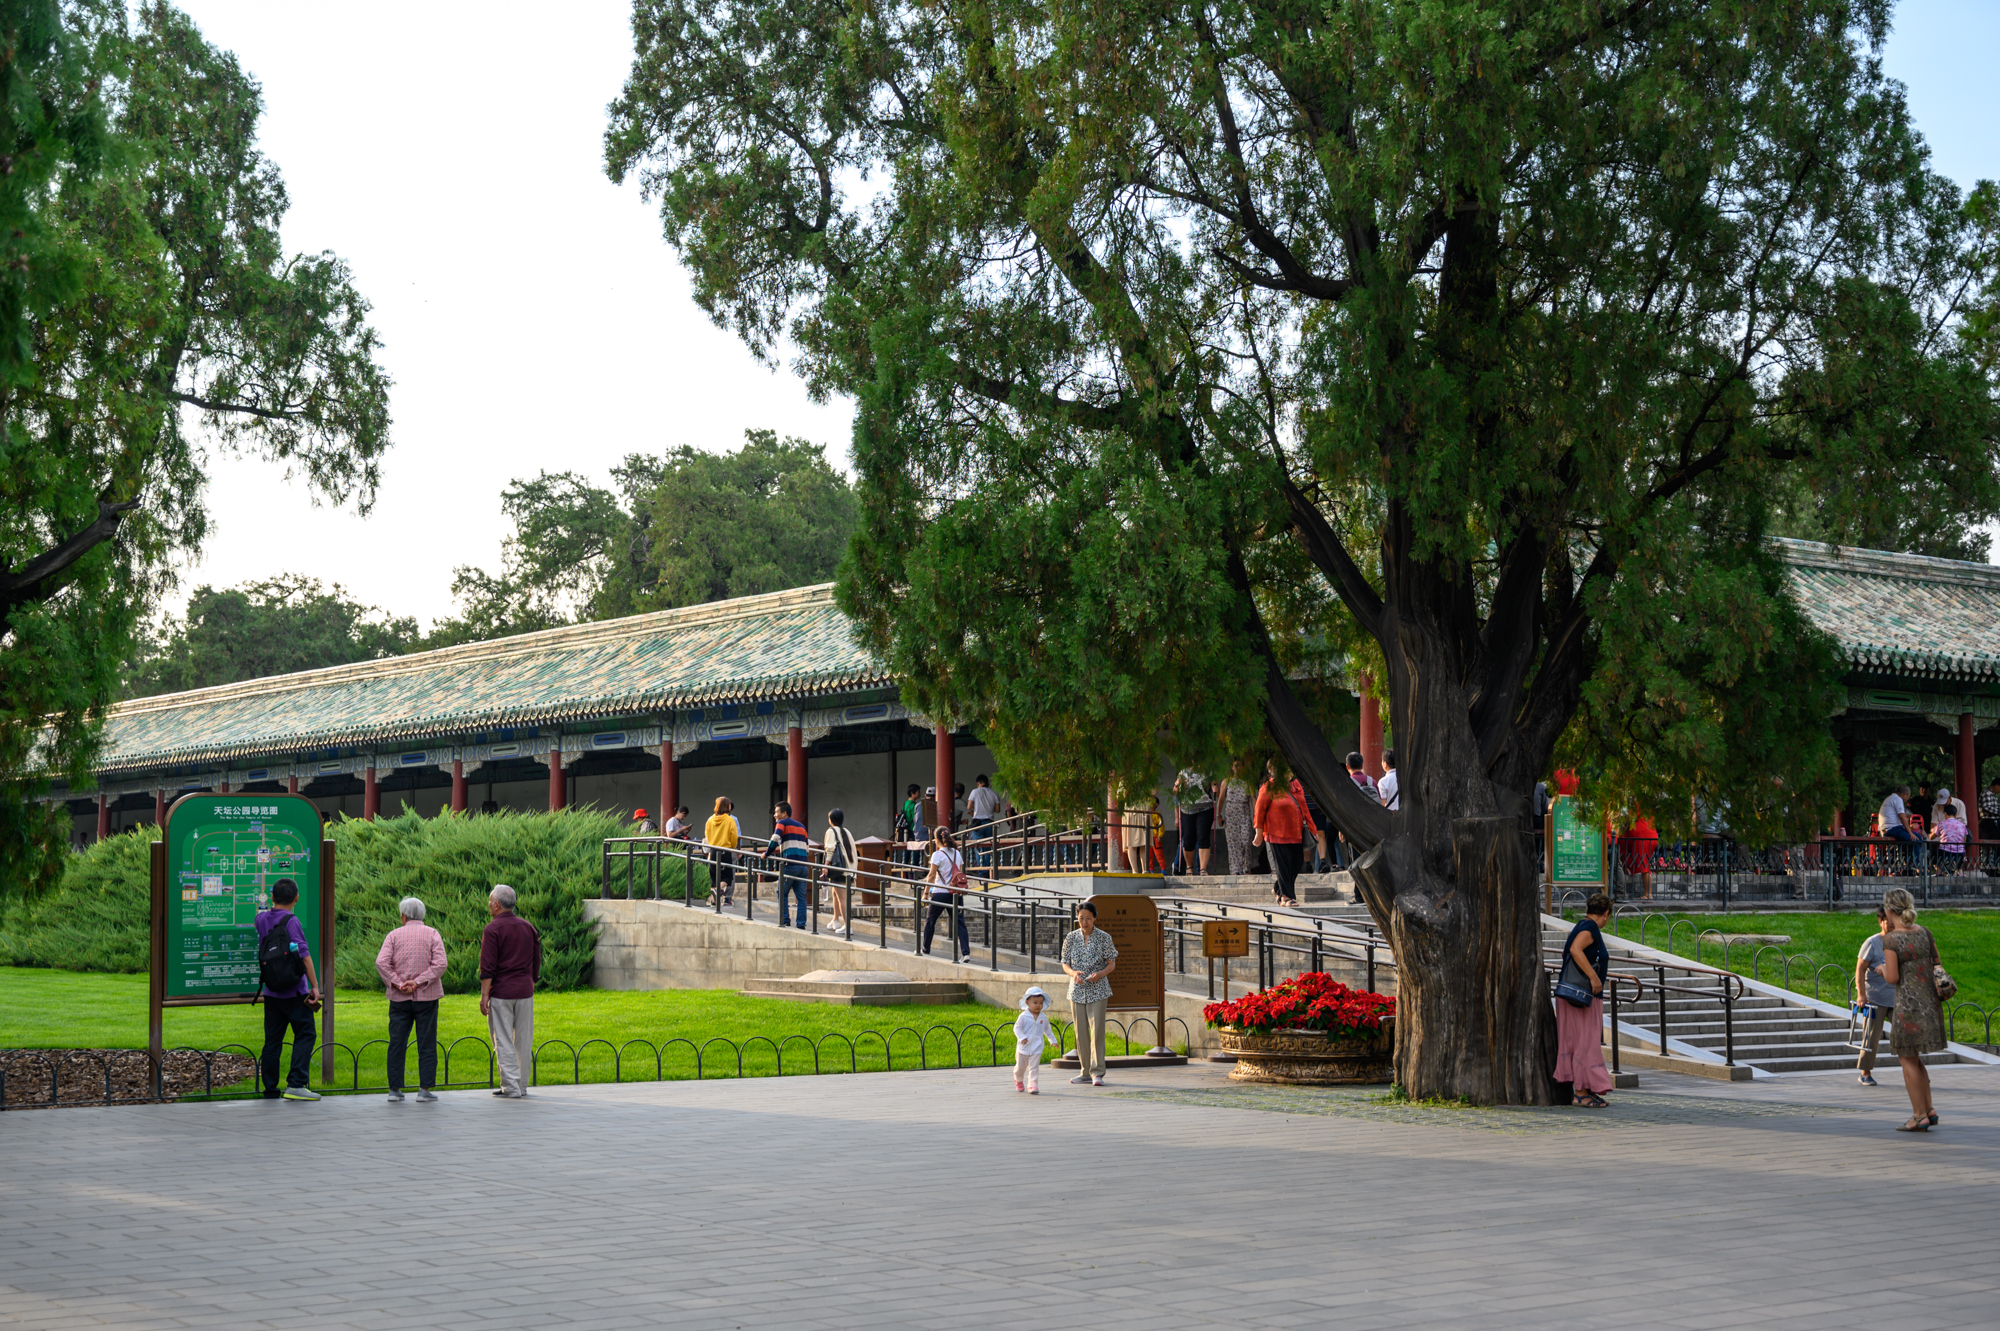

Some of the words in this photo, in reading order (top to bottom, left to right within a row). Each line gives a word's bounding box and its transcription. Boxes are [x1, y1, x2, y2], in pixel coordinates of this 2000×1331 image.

[214, 806, 278, 815] 天坛公园导览图
